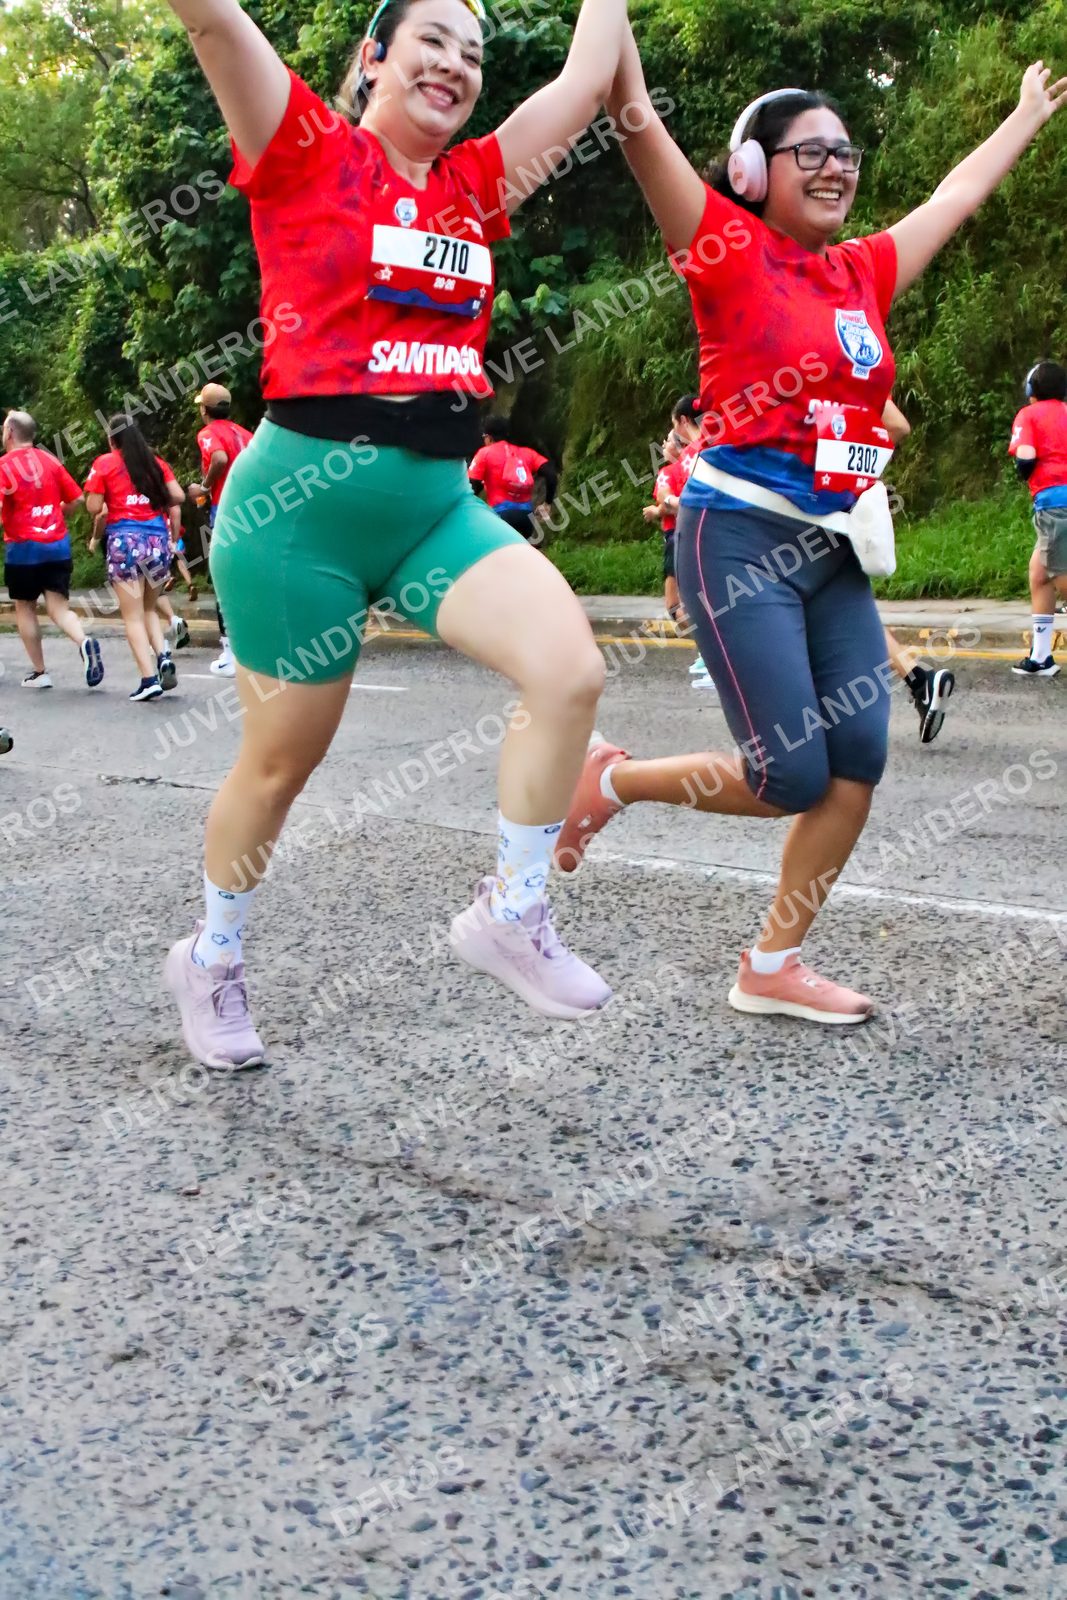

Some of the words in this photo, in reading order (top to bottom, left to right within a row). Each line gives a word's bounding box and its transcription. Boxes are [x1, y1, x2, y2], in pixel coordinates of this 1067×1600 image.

[423, 236, 469, 275] 2710
[368, 340, 482, 376] SANTIAGO
[847, 444, 878, 474] 2302
